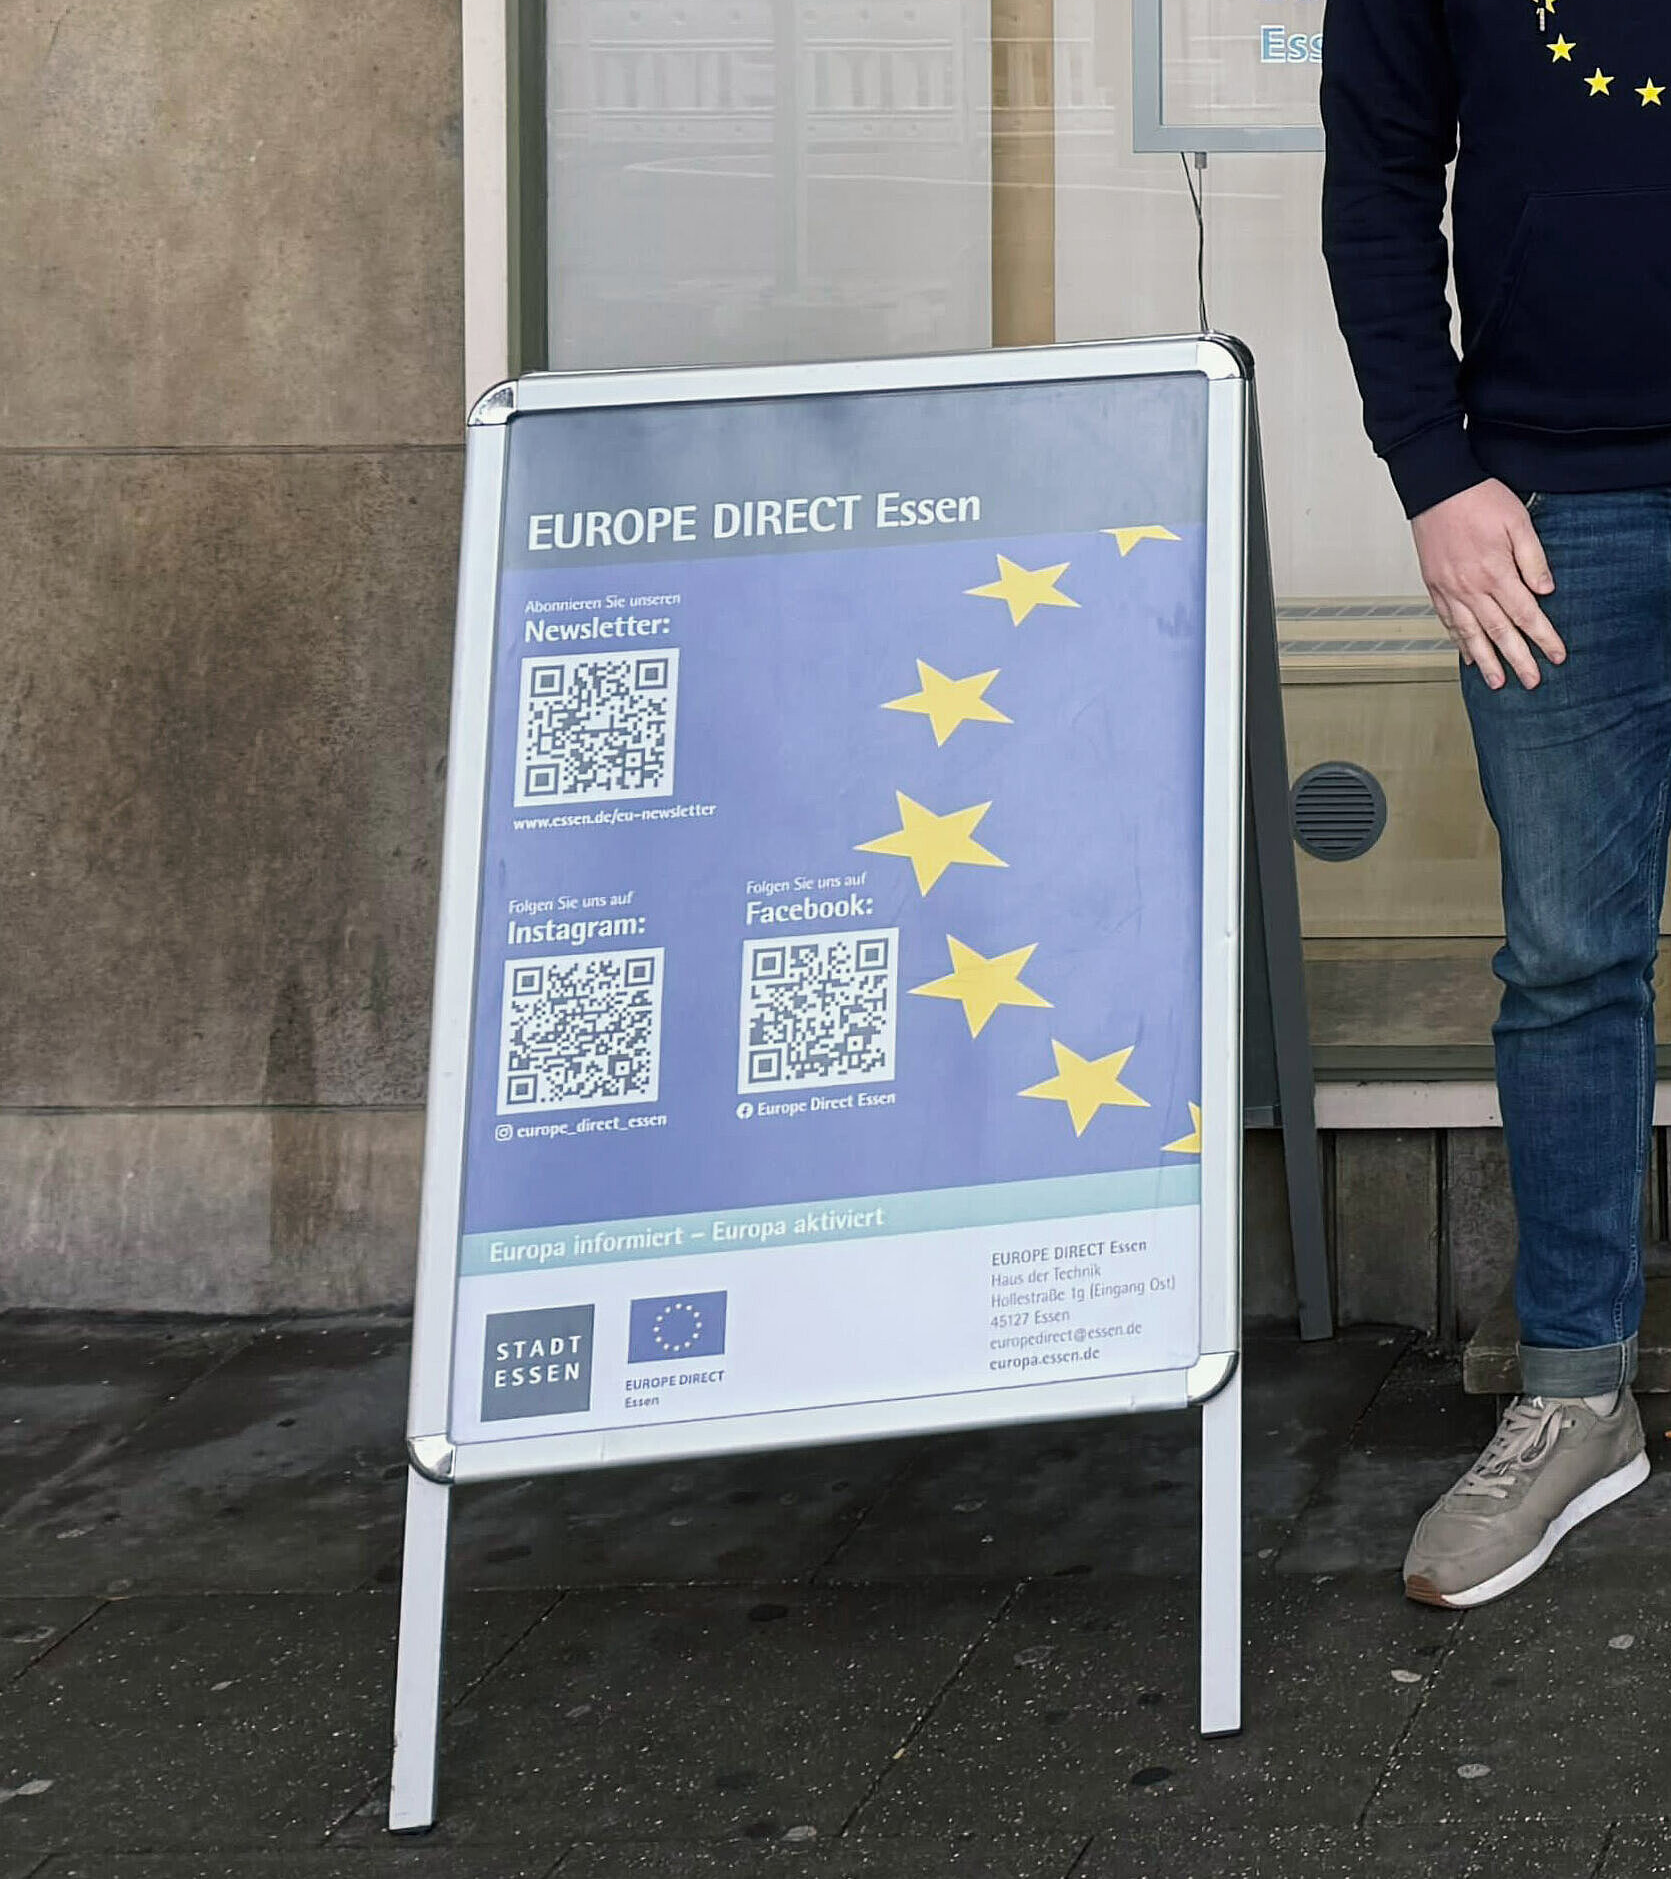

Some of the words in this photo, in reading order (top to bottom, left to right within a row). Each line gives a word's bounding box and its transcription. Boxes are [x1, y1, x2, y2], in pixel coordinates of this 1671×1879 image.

[527, 504, 697, 551] EUROPE
[713, 494, 862, 539] DIRECT
[876, 491, 981, 528] Essen
[524, 597, 602, 614] Abonnieren
[605, 594, 626, 609] Sie
[629, 593, 681, 607] unseren
[524, 616, 671, 643] Newsletter:
[513, 803, 717, 830] www.essen.de/eu-newsletter
[747, 879, 790, 896] Folgen
[793, 876, 814, 891] Sie
[817, 875, 842, 889] uns
[844, 871, 866, 887] auf
[508, 897, 555, 915] Folgen
[557, 895, 578, 910] Sie
[582, 894, 607, 908] uns
[610, 890, 635, 907] auf
[746, 892, 874, 925] Facebook:
[507, 914, 647, 946] Instagram:
[757, 1099, 807, 1118] Europe
[810, 1094, 854, 1112] Direct
[857, 1091, 897, 1107] Essen
[516, 1112, 668, 1141] europe_direct_essen
[489, 1239, 566, 1264] Europa
[573, 1226, 685, 1257] informiert
[711, 1218, 787, 1244] Europa
[793, 1206, 885, 1235] aktiviert
[991, 1247, 1051, 1267] EUROPE
[1053, 1241, 1106, 1261] DIRECT
[1109, 1239, 1148, 1255] Essen
[990, 1272, 1025, 1288] Haus
[1027, 1269, 1050, 1285] der
[1053, 1263, 1102, 1282] Technik
[990, 1289, 1066, 1309] Hollestraße
[1071, 1287, 1086, 1303] 1g
[1089, 1281, 1146, 1300] (Eingang
[1148, 1274, 1177, 1292] Ost)
[989, 1312, 1030, 1329] 45127
[1033, 1309, 1071, 1325] Essen
[496, 1335, 582, 1361] STADT
[989, 1321, 1143, 1351] europedirect@essen.de
[989, 1347, 1101, 1371] europa.essen.de
[494, 1362, 580, 1389] ESSEN
[625, 1373, 677, 1392] EUROPE
[678, 1369, 725, 1387] DIRECT
[624, 1395, 660, 1410] Essen
